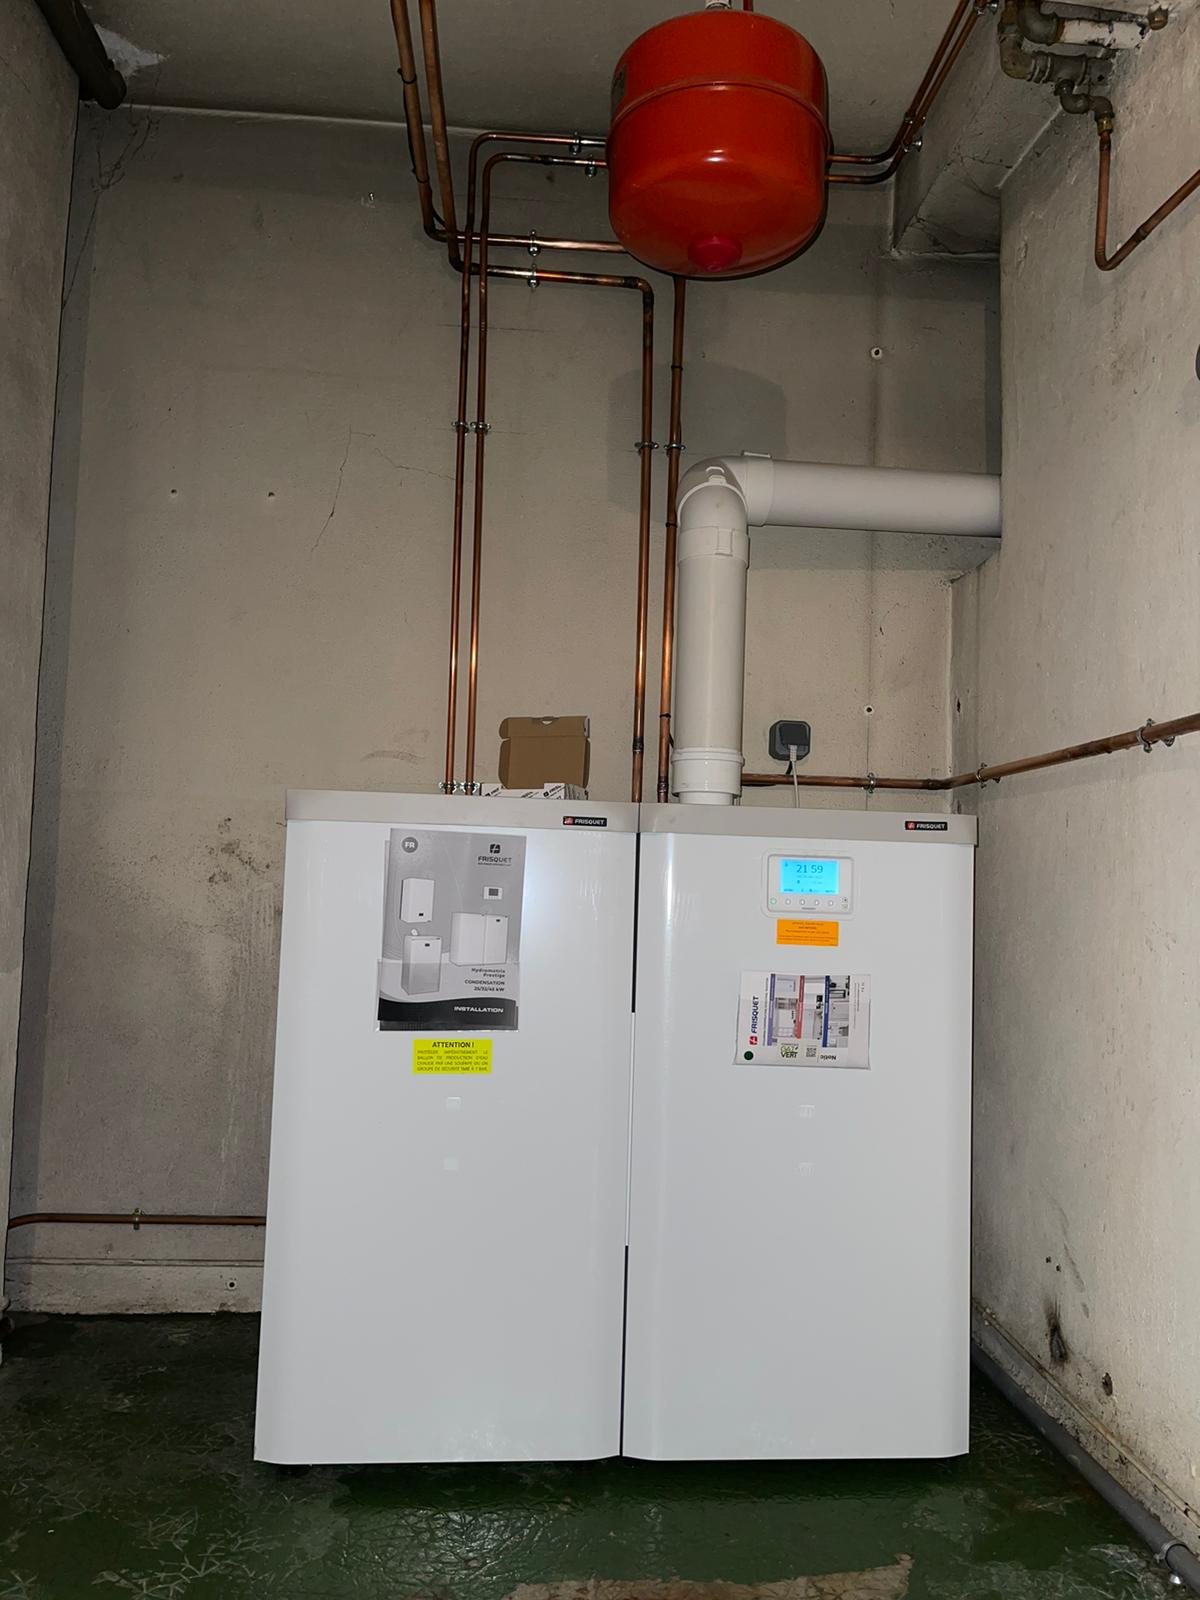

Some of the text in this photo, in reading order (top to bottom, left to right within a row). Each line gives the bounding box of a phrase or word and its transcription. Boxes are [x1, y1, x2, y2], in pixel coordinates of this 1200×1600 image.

[796, 864, 824, 874] 21 59
[751, 996, 759, 1033] FRISQUET
